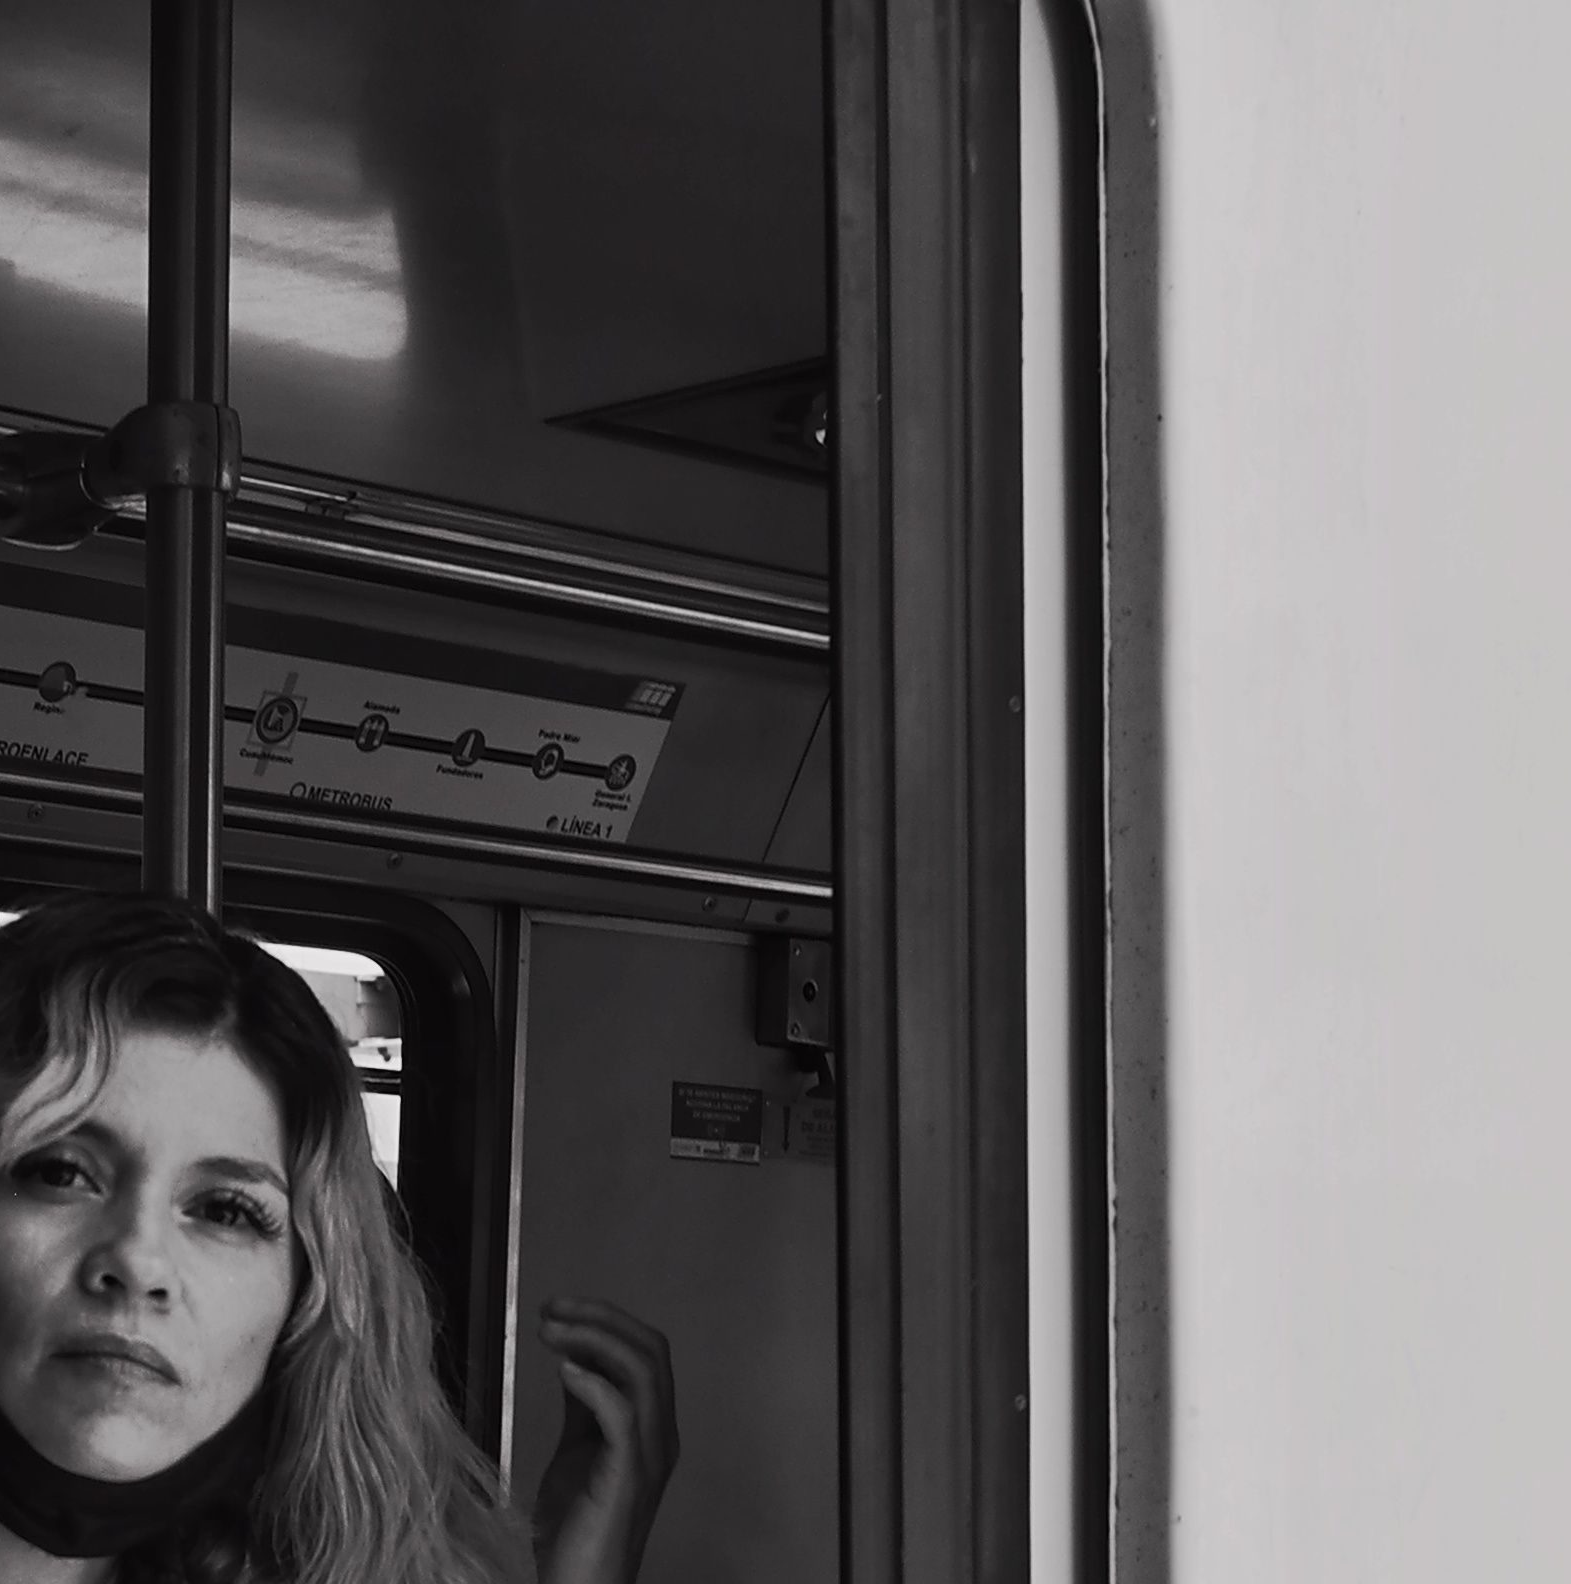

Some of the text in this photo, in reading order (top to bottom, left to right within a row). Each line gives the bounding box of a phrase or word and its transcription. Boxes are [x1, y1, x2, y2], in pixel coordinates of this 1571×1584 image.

[307, 786, 393, 810] METROBUS
[560, 815, 613, 839] LÍNEA 1
